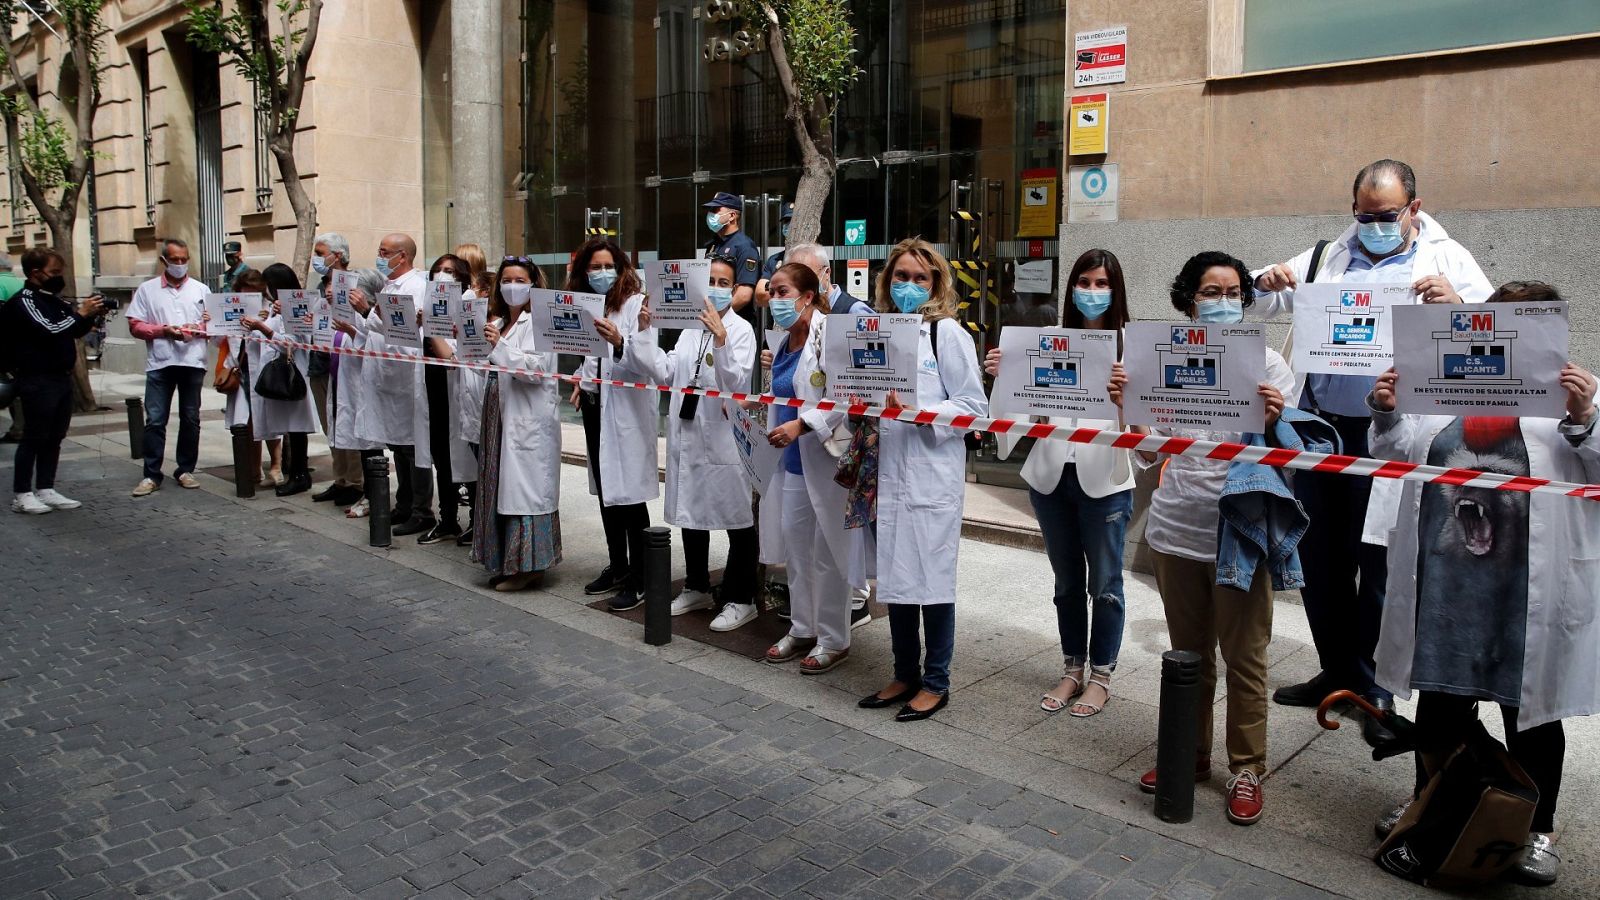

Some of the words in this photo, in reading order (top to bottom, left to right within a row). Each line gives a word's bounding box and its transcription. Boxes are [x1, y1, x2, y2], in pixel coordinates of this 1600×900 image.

[704, 37, 730, 63] de
[1079, 73, 1093, 83] 24h
[671, 264, 679, 274] M
[564, 295, 573, 305] M
[1355, 293, 1370, 306] M
[867, 318, 878, 331] M
[1472, 314, 1492, 331] M
[1188, 329, 1204, 344] M
[1053, 338, 1067, 351] M
[1173, 376, 1208, 384] ÁNGELES
[1175, 408, 1203, 416] MÉDICOS
